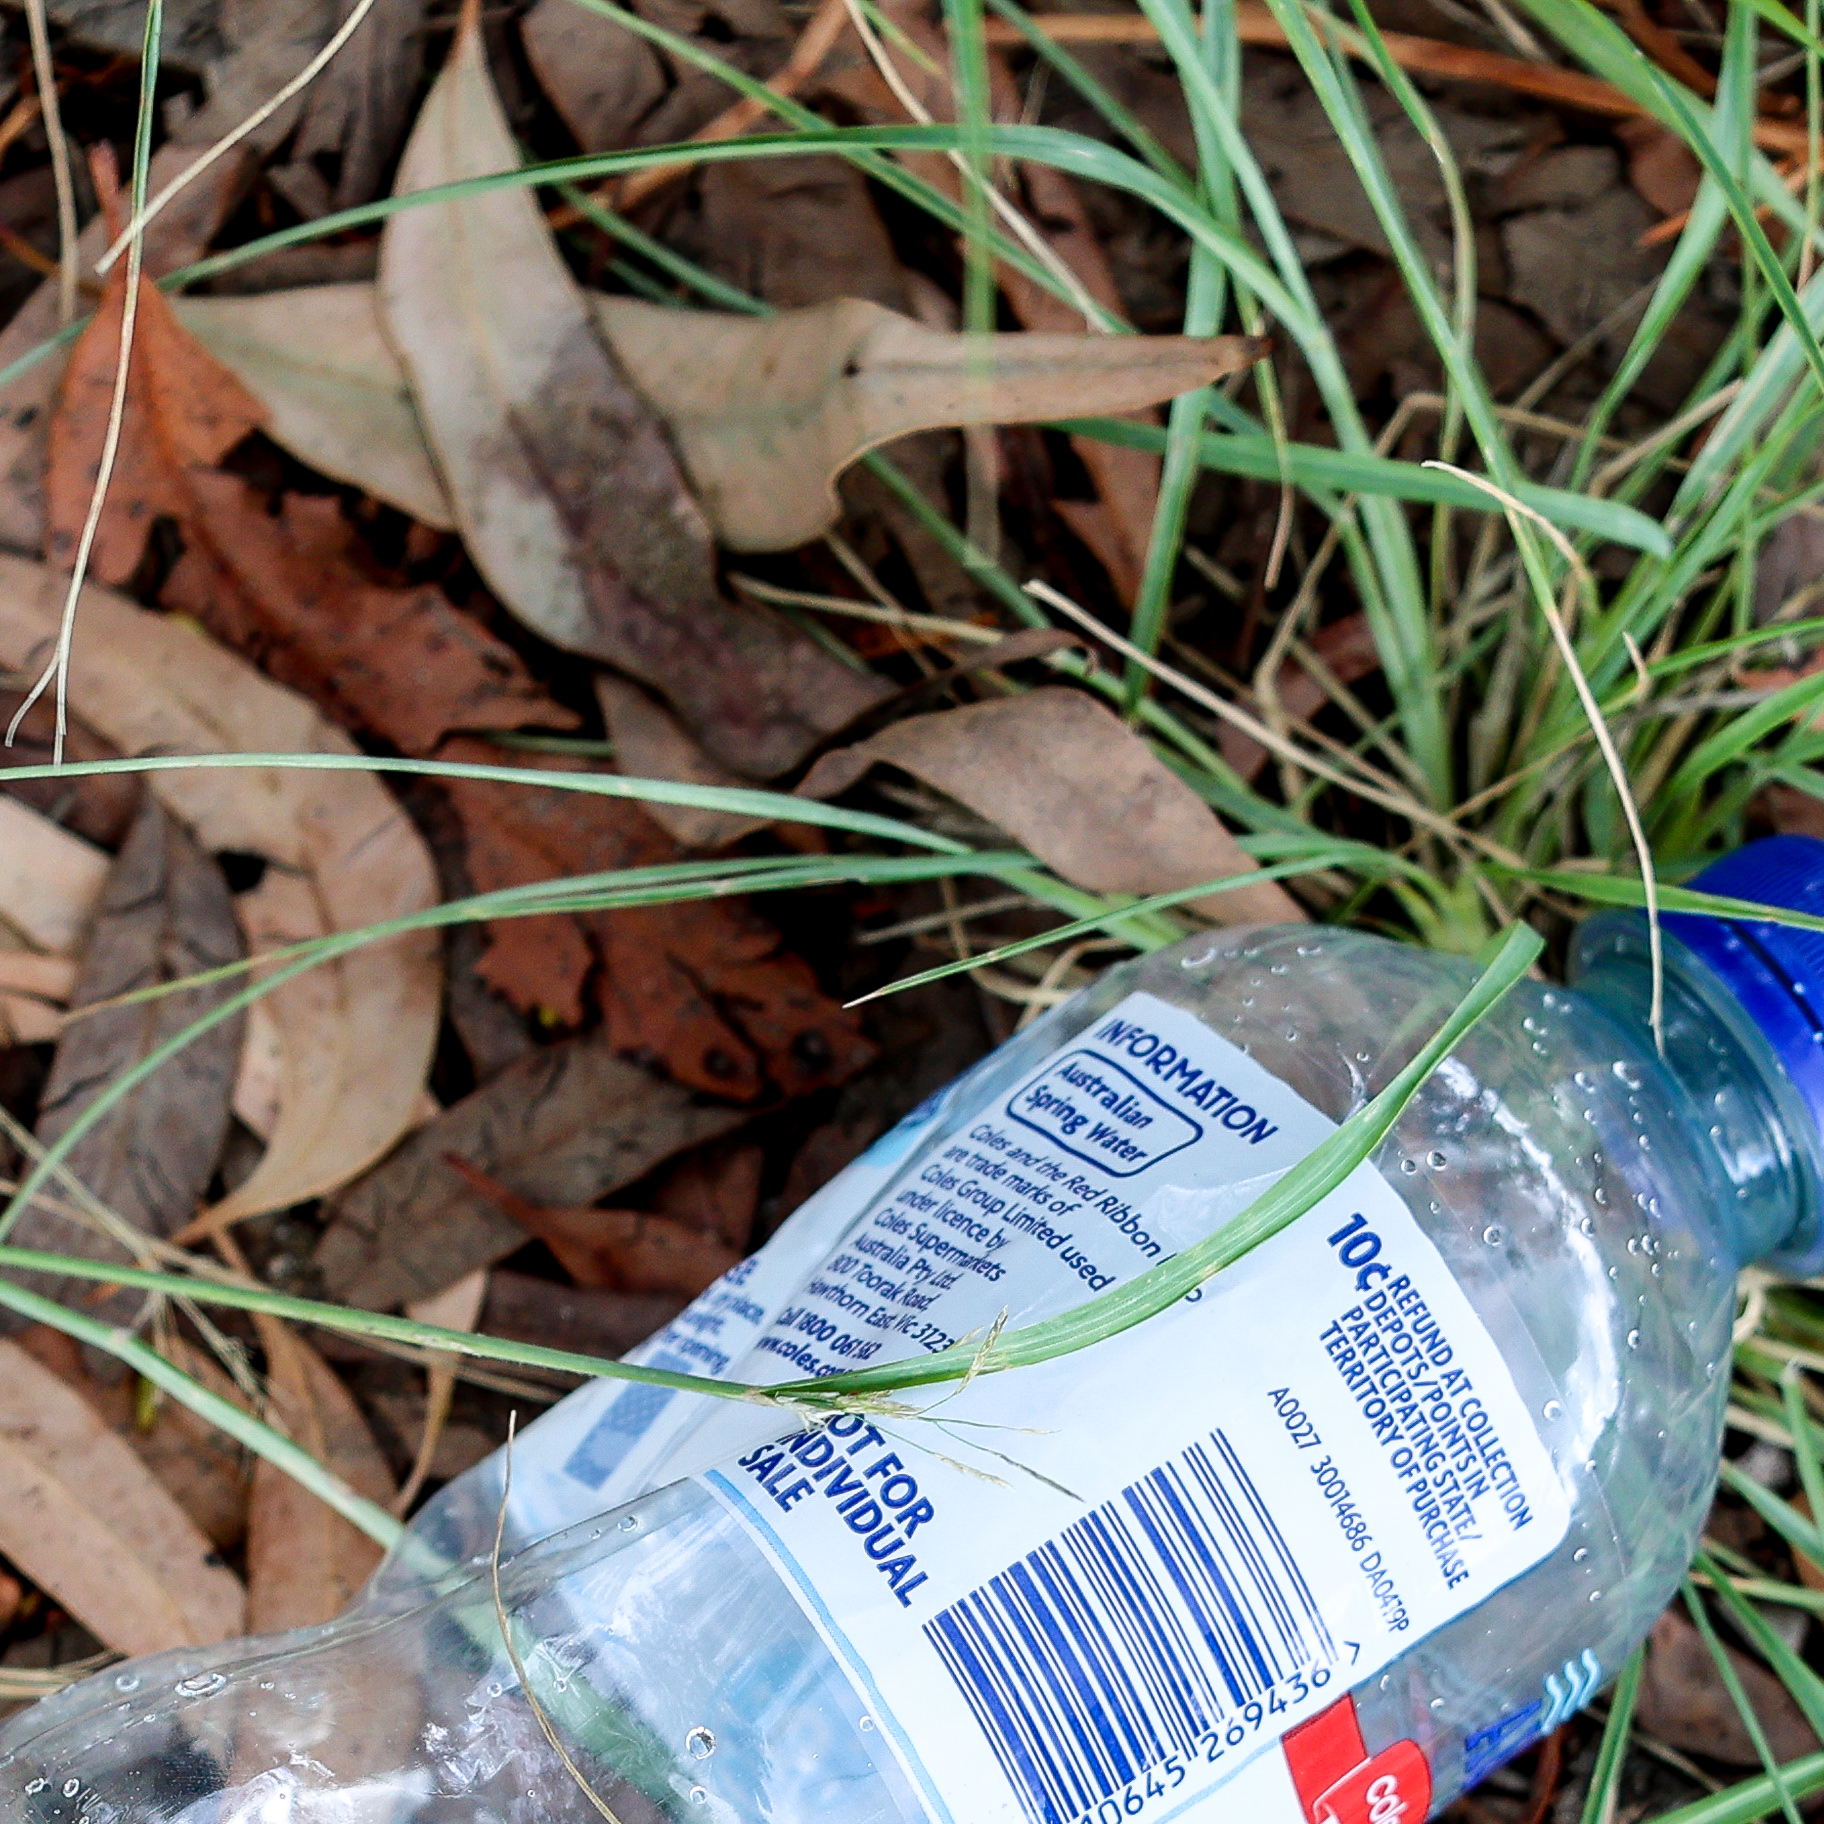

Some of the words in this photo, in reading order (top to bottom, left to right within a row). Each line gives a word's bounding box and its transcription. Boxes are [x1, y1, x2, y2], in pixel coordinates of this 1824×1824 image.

[1024, 1084, 1087, 1136] Spring
[1086, 1120, 1149, 1164] Water
[1056, 1062, 1154, 1130] Australian
[1095, 1018, 1279, 1146] INFORMATION
[895, 1189, 940, 1214] under
[933, 1198, 990, 1244] licence
[985, 1227, 1012, 1259] by
[919, 1162, 960, 1192] Coles
[956, 1178, 1007, 1220] Group
[1001, 1202, 1074, 1252] Limited
[1059, 1245, 1116, 1293] used
[941, 1146, 967, 1164] are
[964, 1151, 1008, 1182] trade
[1005, 1173, 1054, 1205] marks
[1048, 1200, 1084, 1218] of
[969, 1123, 1013, 1153] Coles
[1009, 1146, 1043, 1168] and
[1036, 1160, 1069, 1183] the
[1064, 1174, 1110, 1203] Red
[1097, 1195, 1162, 1259] Ribbon
[851, 1231, 912, 1272] Australia
[907, 1256, 938, 1287] Pty
[853, 1259, 908, 1303] Toorak
[873, 1206, 911, 1236] Coles
[907, 1221, 1007, 1283] Supermarkets
[795, 1310, 839, 1342] 1800
[892, 1312, 919, 1335] Vic
[910, 1322, 956, 1354] 3123
[1326, 1211, 1393, 1292] 10¢
[1386, 1273, 1454, 1368] REFUND
[1439, 1367, 1474, 1400] AT
[1458, 1397, 1534, 1532] COLLECTION
[1318, 1319, 1406, 1448] TERRITORY
[1339, 1304, 1447, 1474] PARTICIPATING
[1431, 1468, 1483, 1541] STATE/
[1362, 1285, 1478, 1473] DEPOTS/POINTS
[1462, 1467, 1491, 1501] IN
[736, 1443, 817, 1514] SALE
[824, 1411, 888, 1458] OT
[861, 1450, 935, 1540] FOR
[1266, 1387, 1323, 1450] A0027
[1309, 1454, 1374, 1553] 30014686
[1389, 1446, 1422, 1480] OF
[1405, 1476, 1470, 1591] PURCHASE
[1199, 1660, 1332, 1764] 269436
